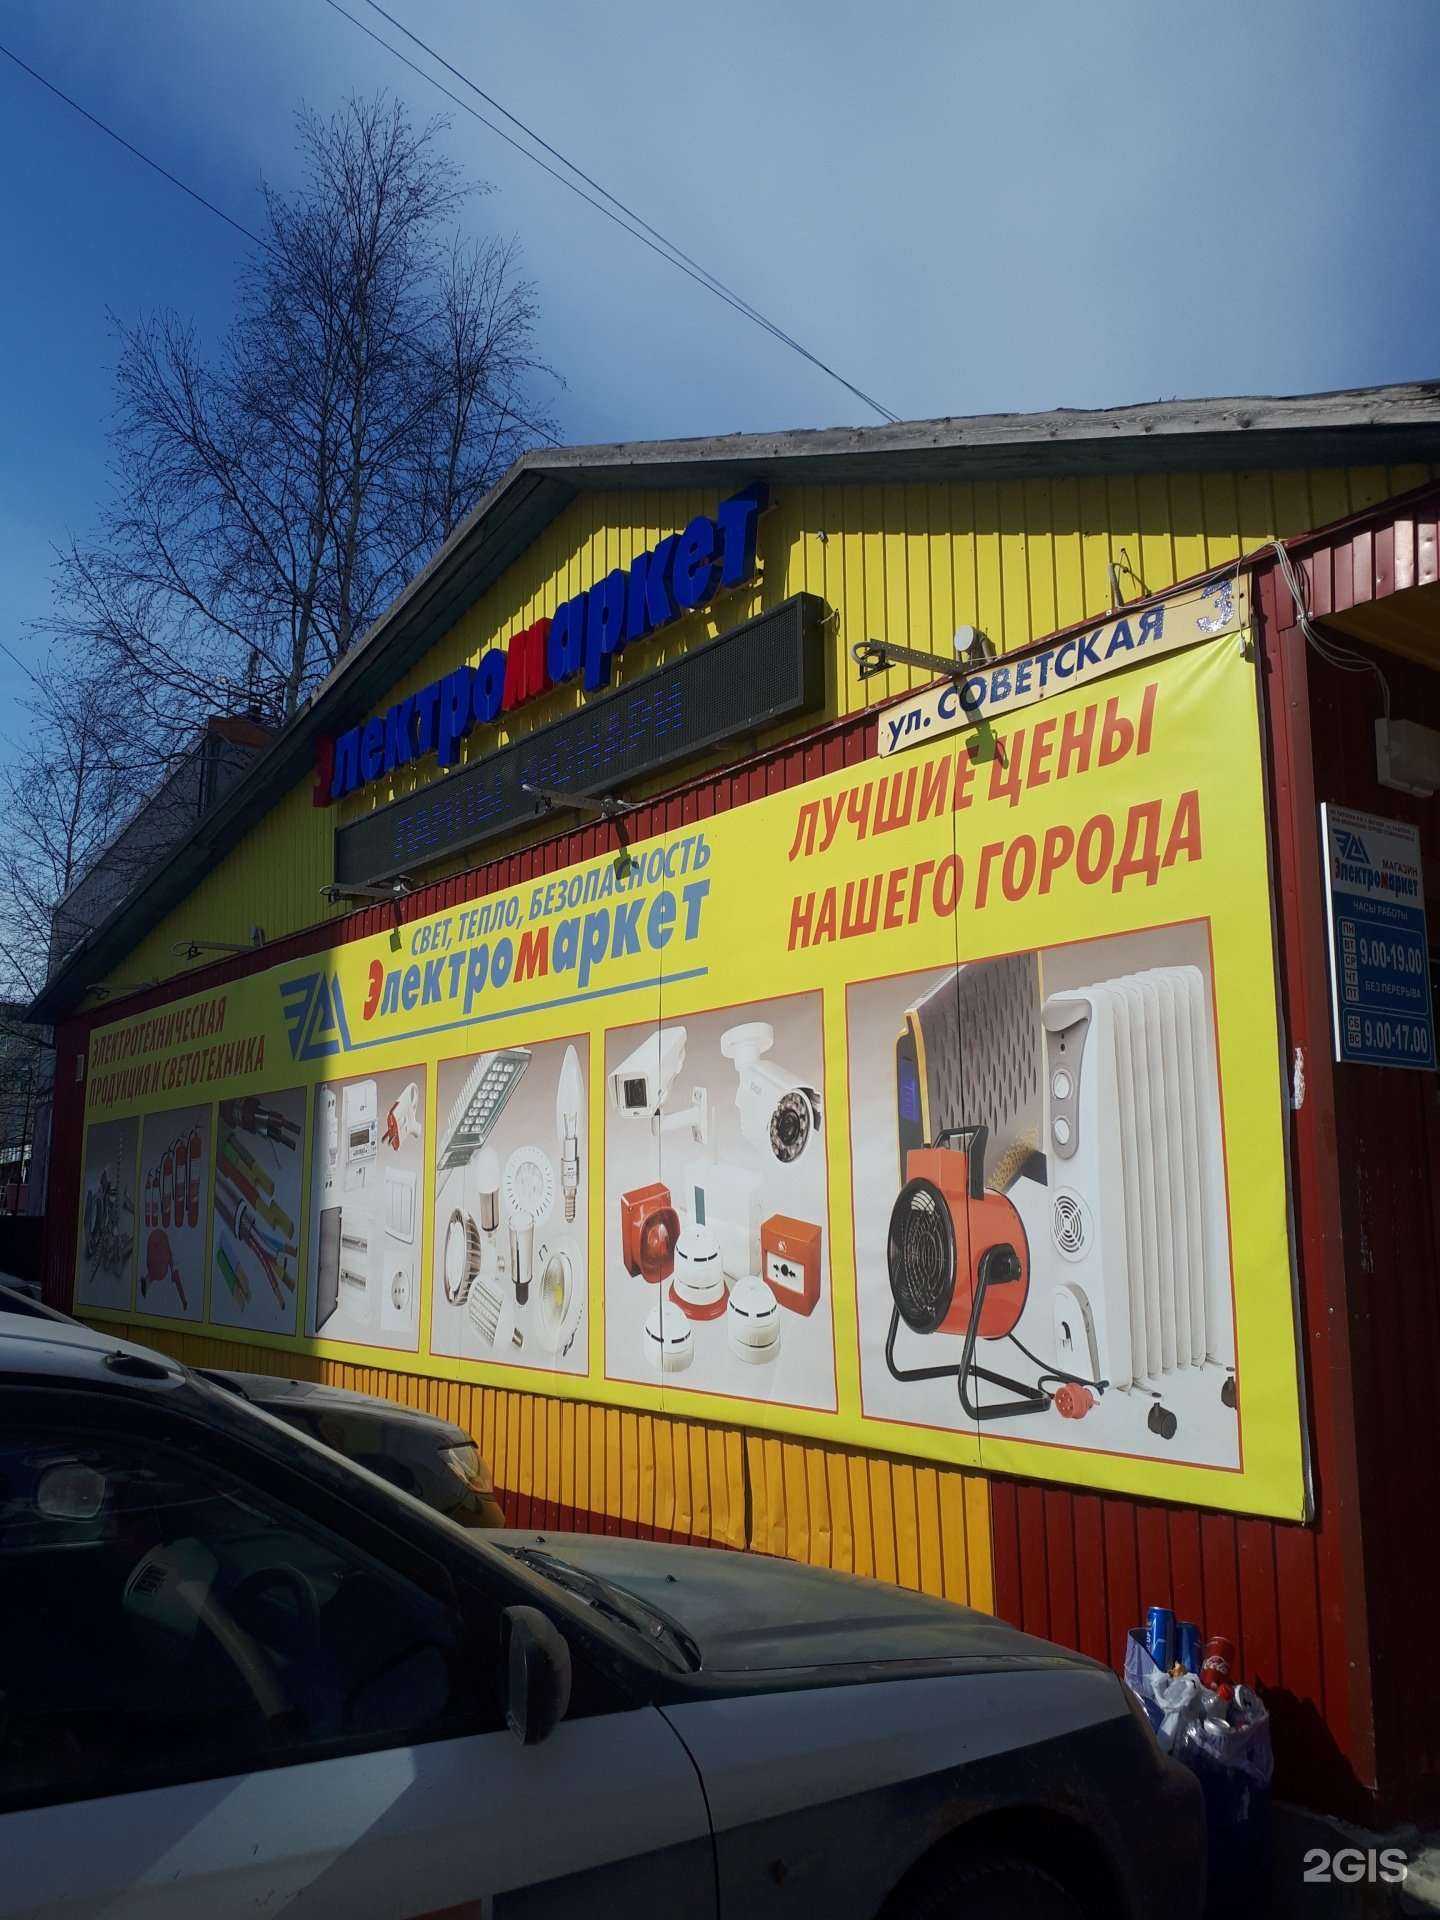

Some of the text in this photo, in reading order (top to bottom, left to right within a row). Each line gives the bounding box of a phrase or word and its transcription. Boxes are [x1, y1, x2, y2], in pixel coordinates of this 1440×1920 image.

[888, 707, 931, 752] ул.
[937, 603, 1166, 721] СОВЕТСКАЯ
[788, 683, 1160, 861] ЛУЧШИЕ ЦЕНЫ
[410, 833, 711, 957] СВЕТ, ТЕПЛО, БЕЗОПАСНОСТЬ
[787, 789, 1202, 952] НАШЕГО ГОРОДА
[1382, 858, 1418, 877] МАГАЗИН
[362, 879, 711, 1021] Электромаркет
[1360, 937, 1422, 975] 9.00-19.00
[89, 1063, 151, 1109] ПРОДУКЦИЯ
[161, 1034, 266, 1091] СВЕТОТЕХНИКА
[91, 995, 228, 1069] ЭЛЕКТРОТЕХНИЧЕСКАЯ
[1364, 1020, 1428, 1053] 9.00-17.00
